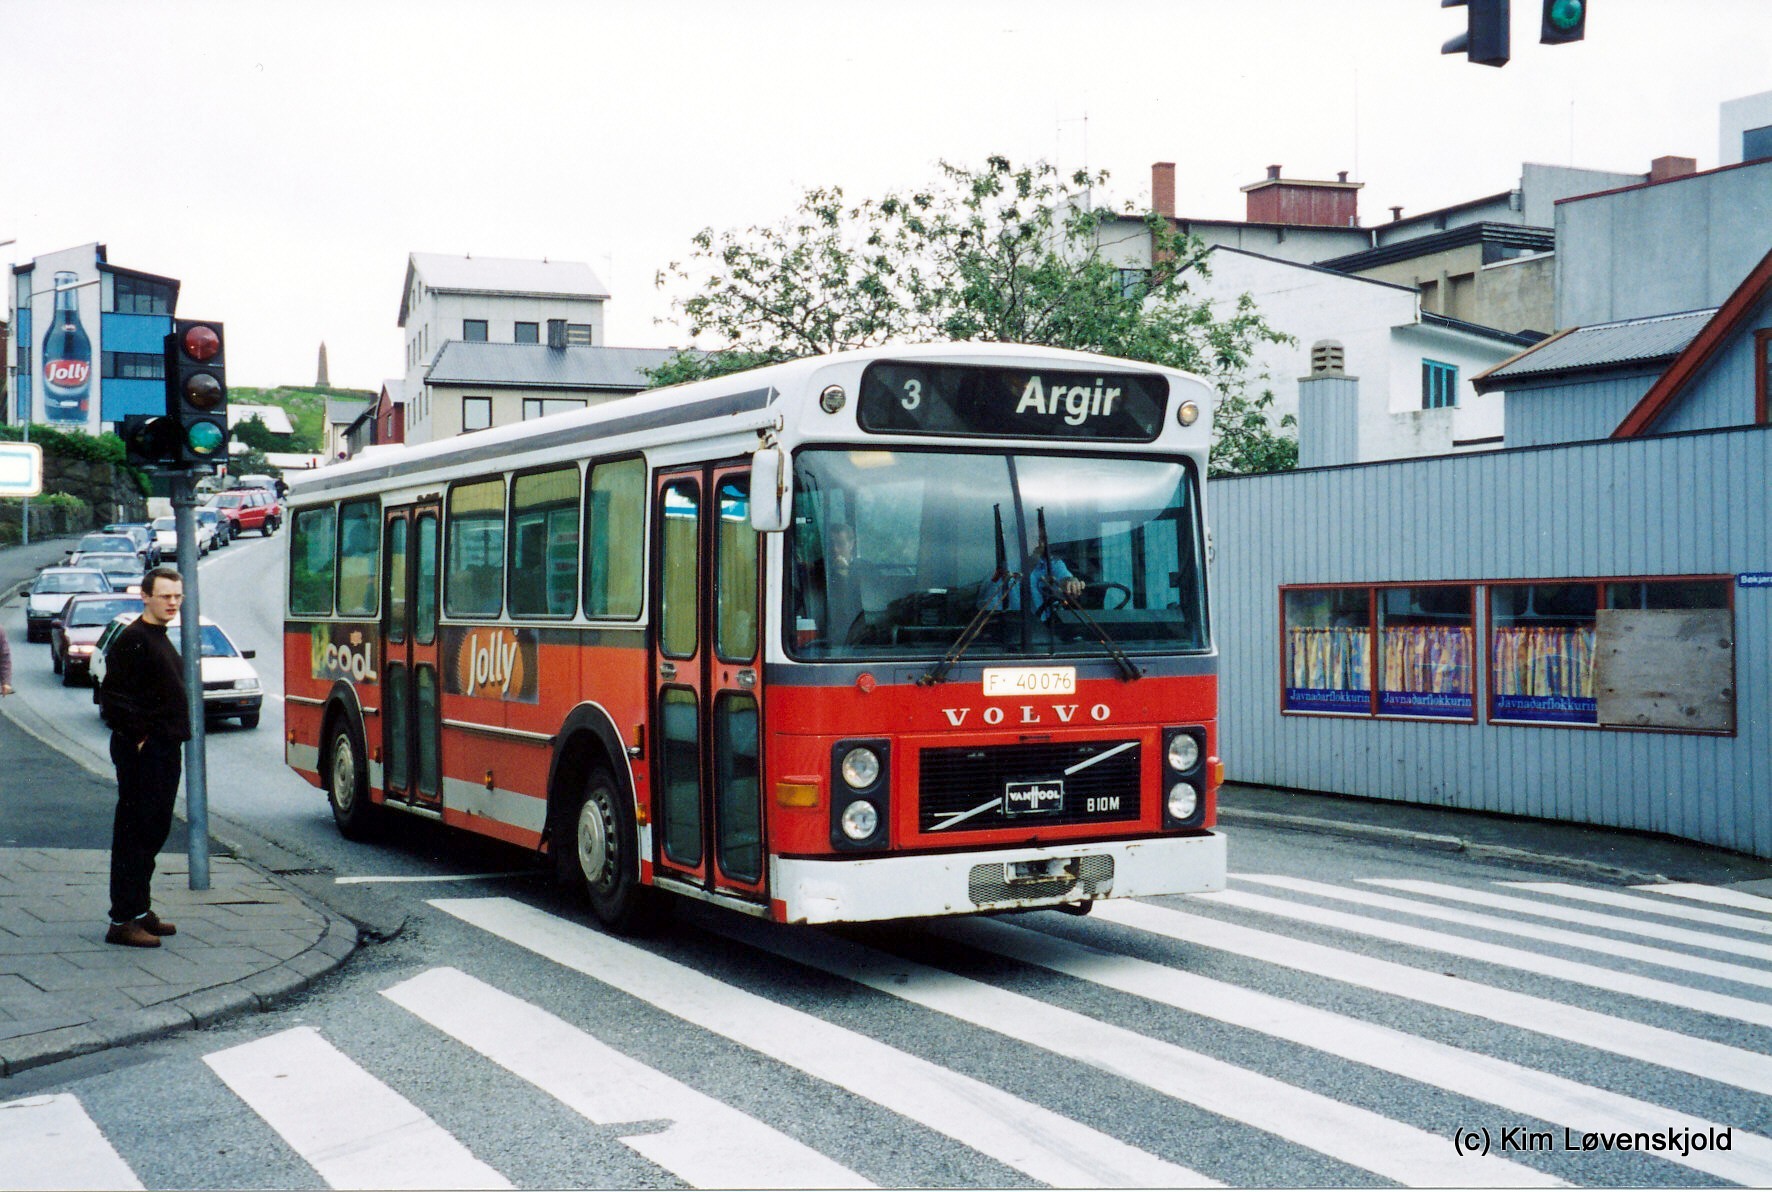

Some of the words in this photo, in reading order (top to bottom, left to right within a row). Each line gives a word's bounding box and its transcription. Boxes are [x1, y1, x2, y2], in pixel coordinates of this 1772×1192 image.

[48, 363, 89, 382] Jolly
[901, 378, 922, 410] 3
[1016, 375, 1120, 426] Argir
[467, 630, 518, 696] Jolly
[1016, 672, 1072, 690] 40076
[942, 703, 1111, 726] VOLVO
